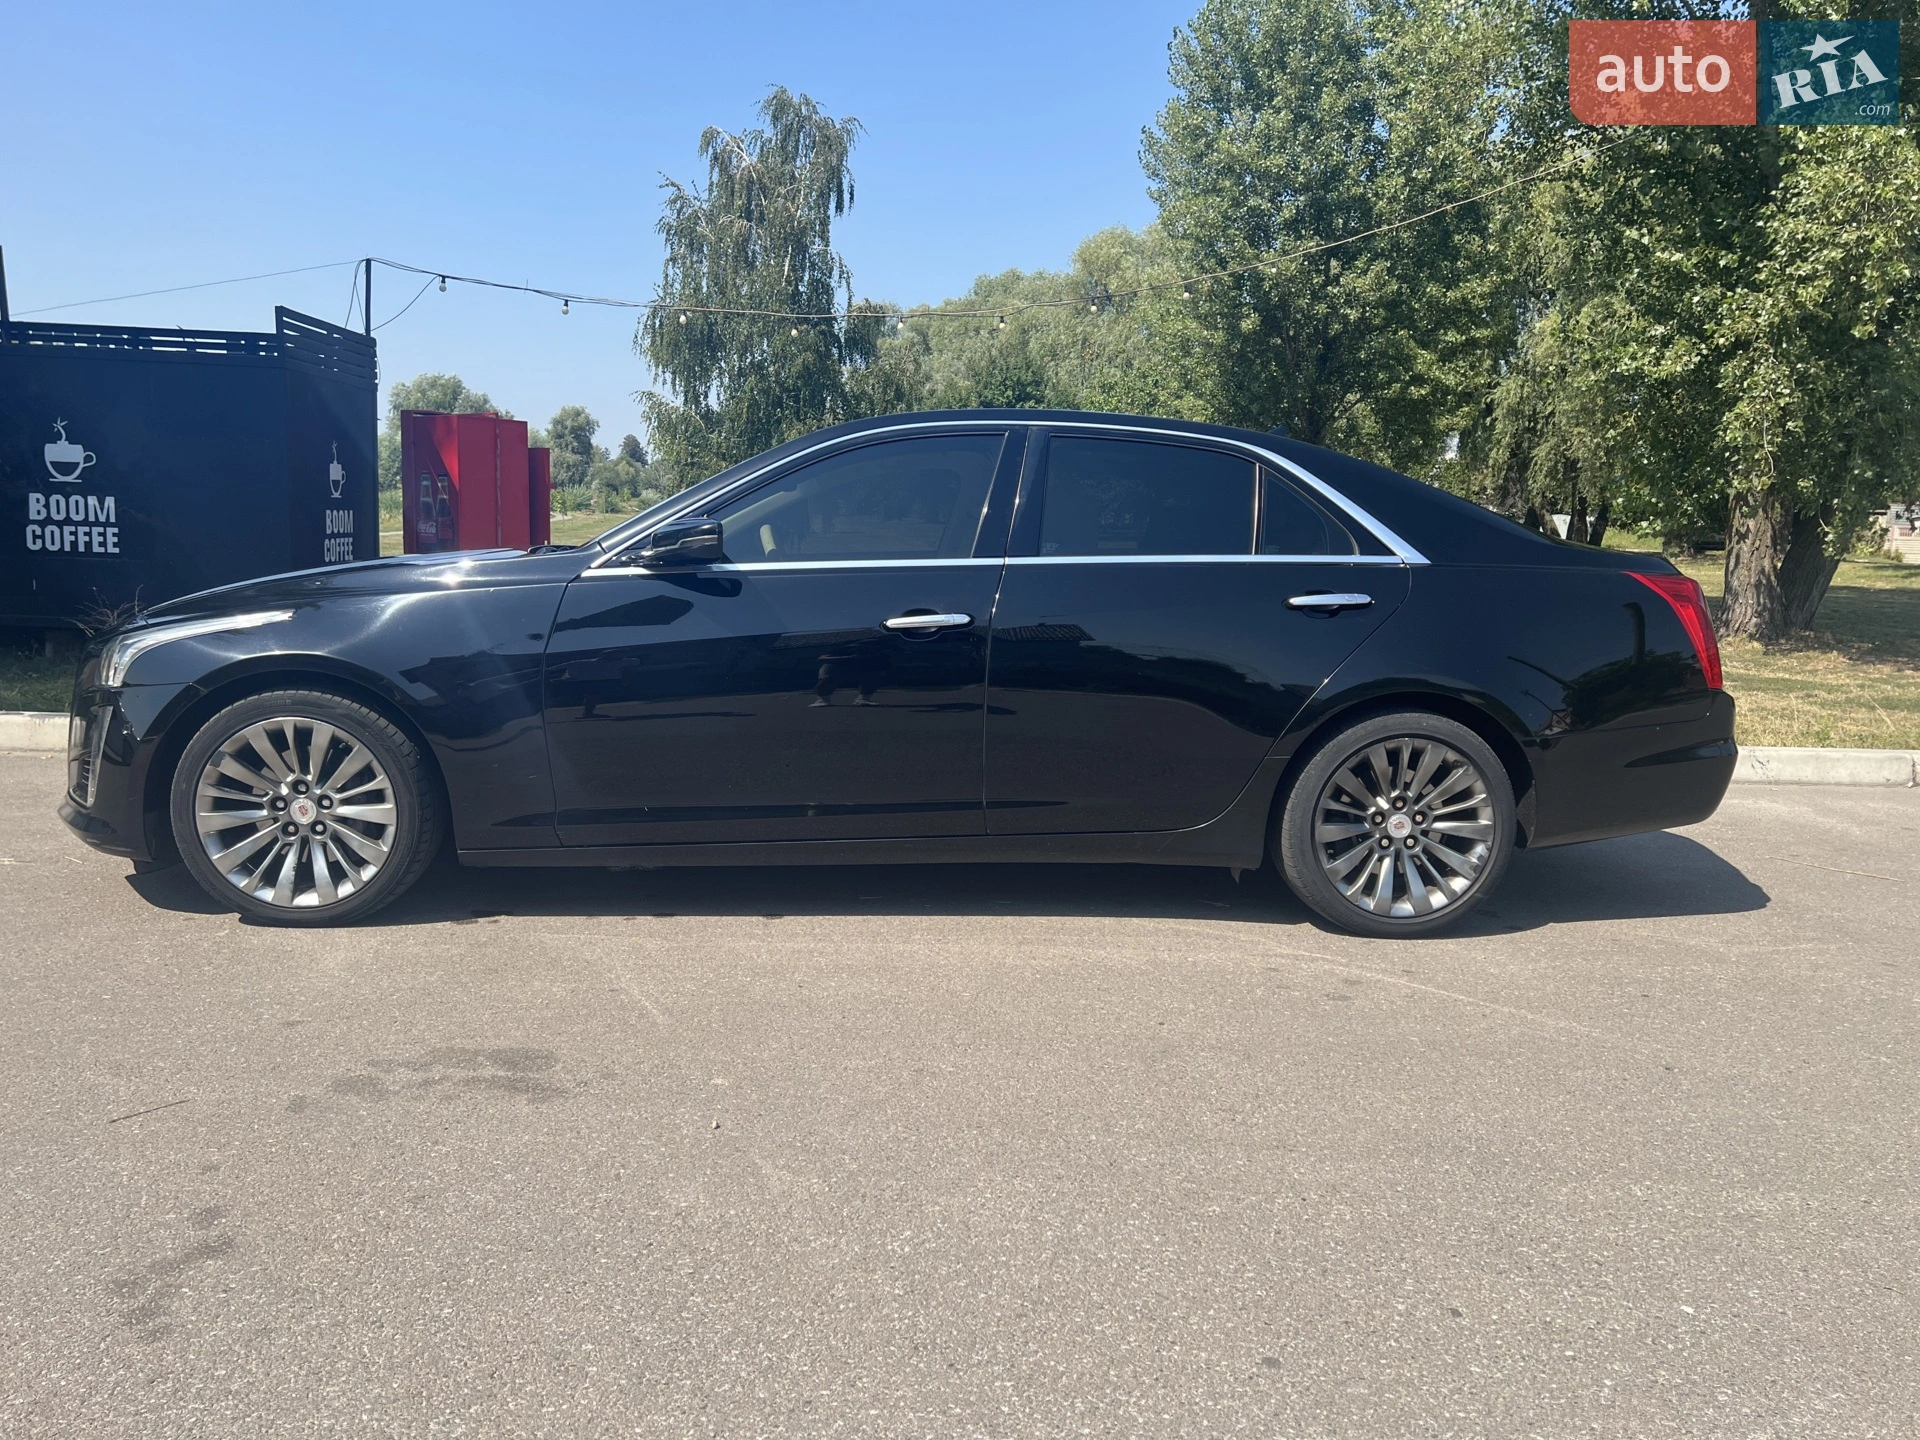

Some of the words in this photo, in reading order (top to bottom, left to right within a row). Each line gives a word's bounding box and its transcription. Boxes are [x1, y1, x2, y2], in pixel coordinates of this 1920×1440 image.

[28, 493, 116, 522] BOOM
[326, 510, 353, 534] BOOM
[26, 524, 120, 554] COFFEE
[324, 538, 353, 562] COFFEE
